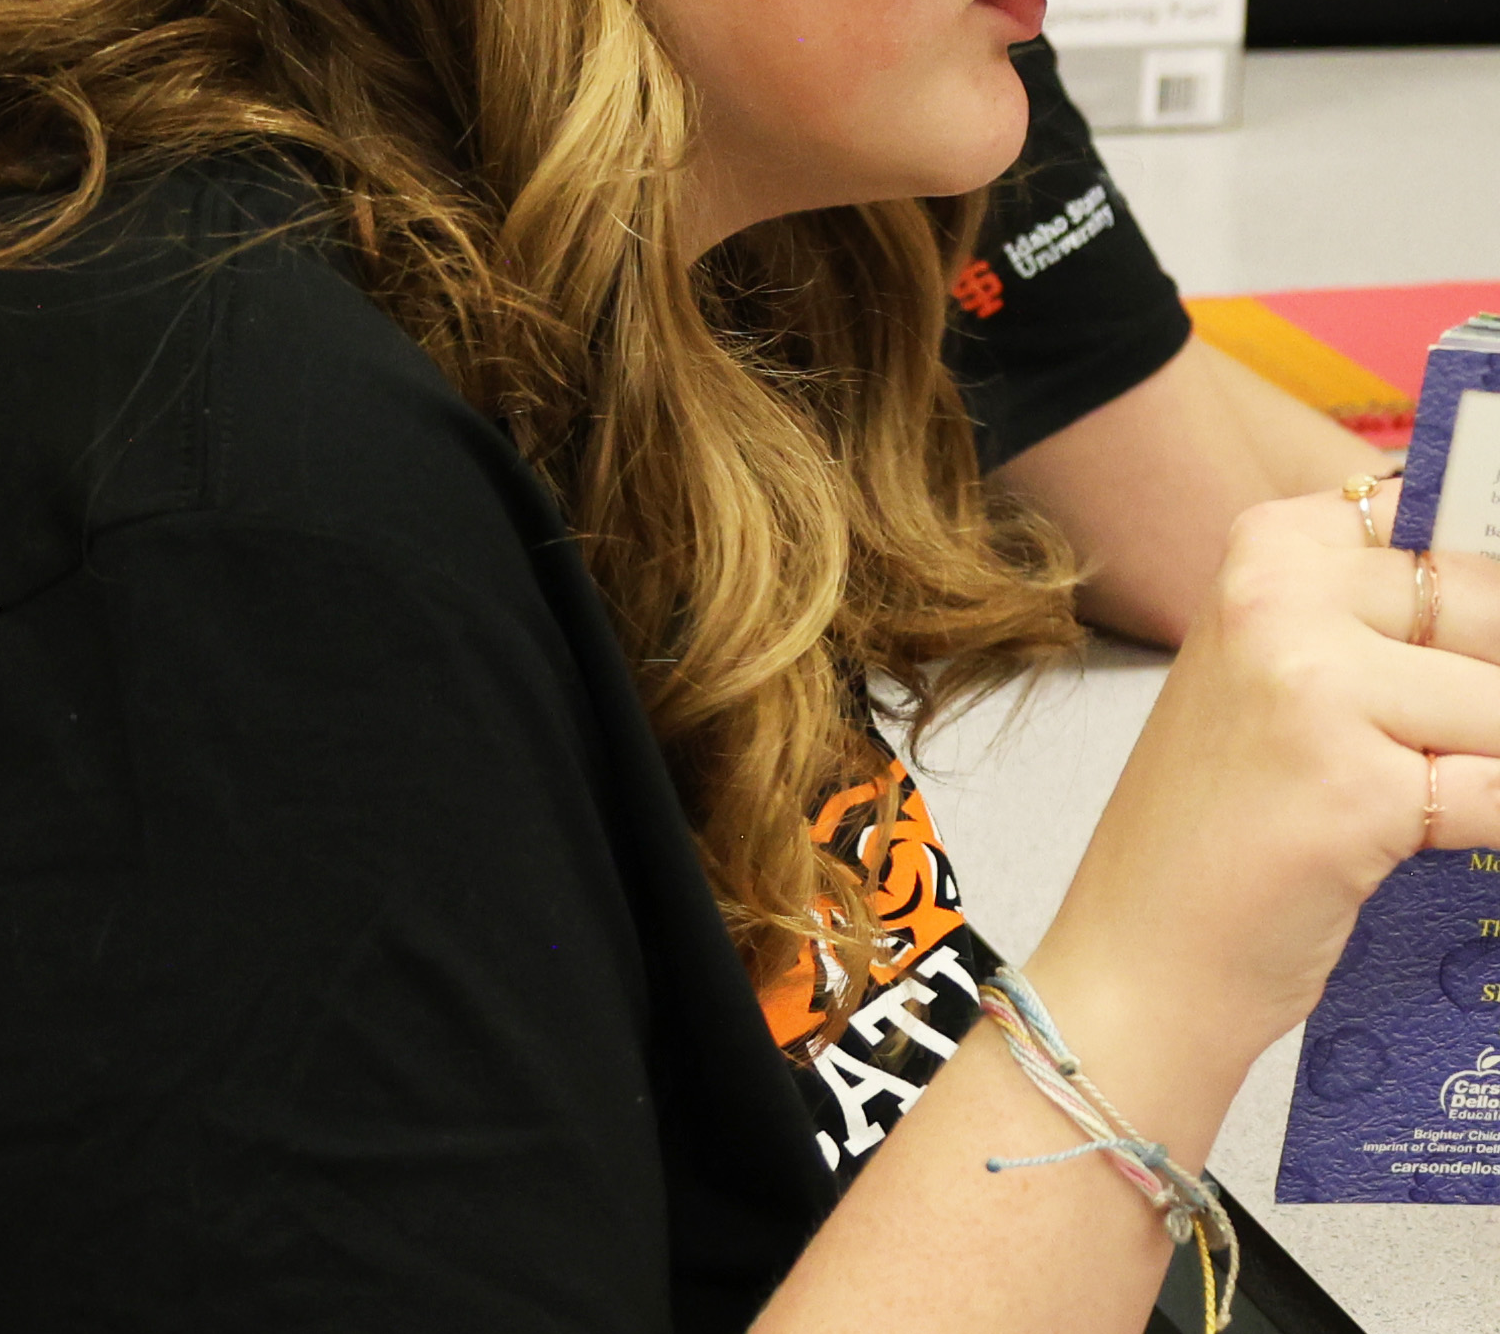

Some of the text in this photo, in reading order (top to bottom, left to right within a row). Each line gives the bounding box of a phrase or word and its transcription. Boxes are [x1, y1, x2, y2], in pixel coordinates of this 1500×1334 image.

[1003, 214, 1070, 275] Idaho
[1012, 203, 1115, 280] University
[1364, 1142, 1408, 1152] imprint
[1411, 1143, 1424, 1152] of
[1427, 1143, 1472, 1153] Carson
[1414, 1129, 1464, 1141] Brighter
